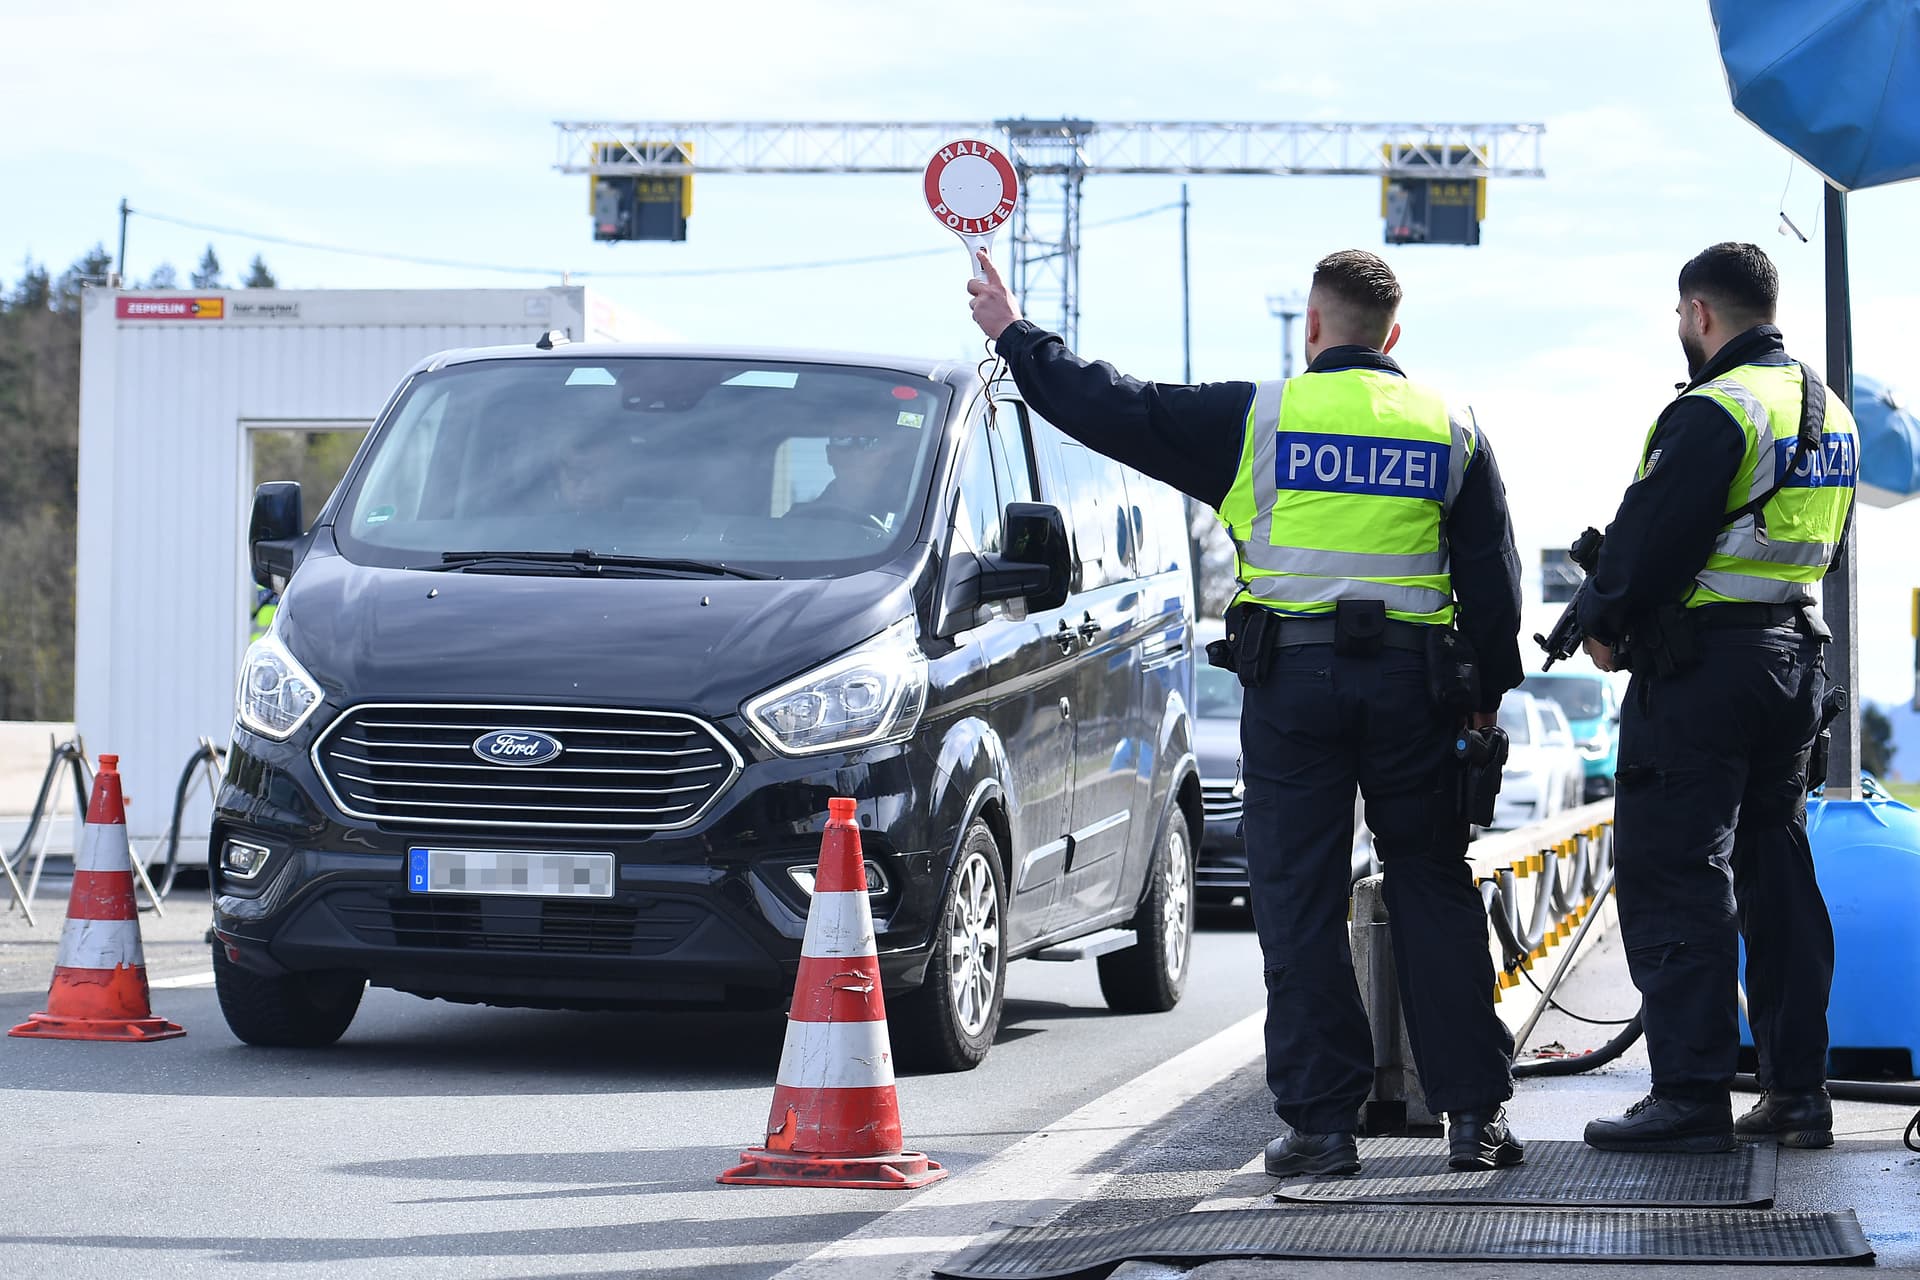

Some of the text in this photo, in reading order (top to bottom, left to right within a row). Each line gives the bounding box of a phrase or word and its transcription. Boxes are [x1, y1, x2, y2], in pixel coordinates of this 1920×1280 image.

[939, 142, 995, 163] HALT
[933, 198, 1015, 233] POLIZEI
[127, 303, 185, 314] ZEPPELIN
[1288, 443, 1437, 489] POLIZEI
[490, 734, 540, 756] Ford
[415, 875, 423, 885] D
